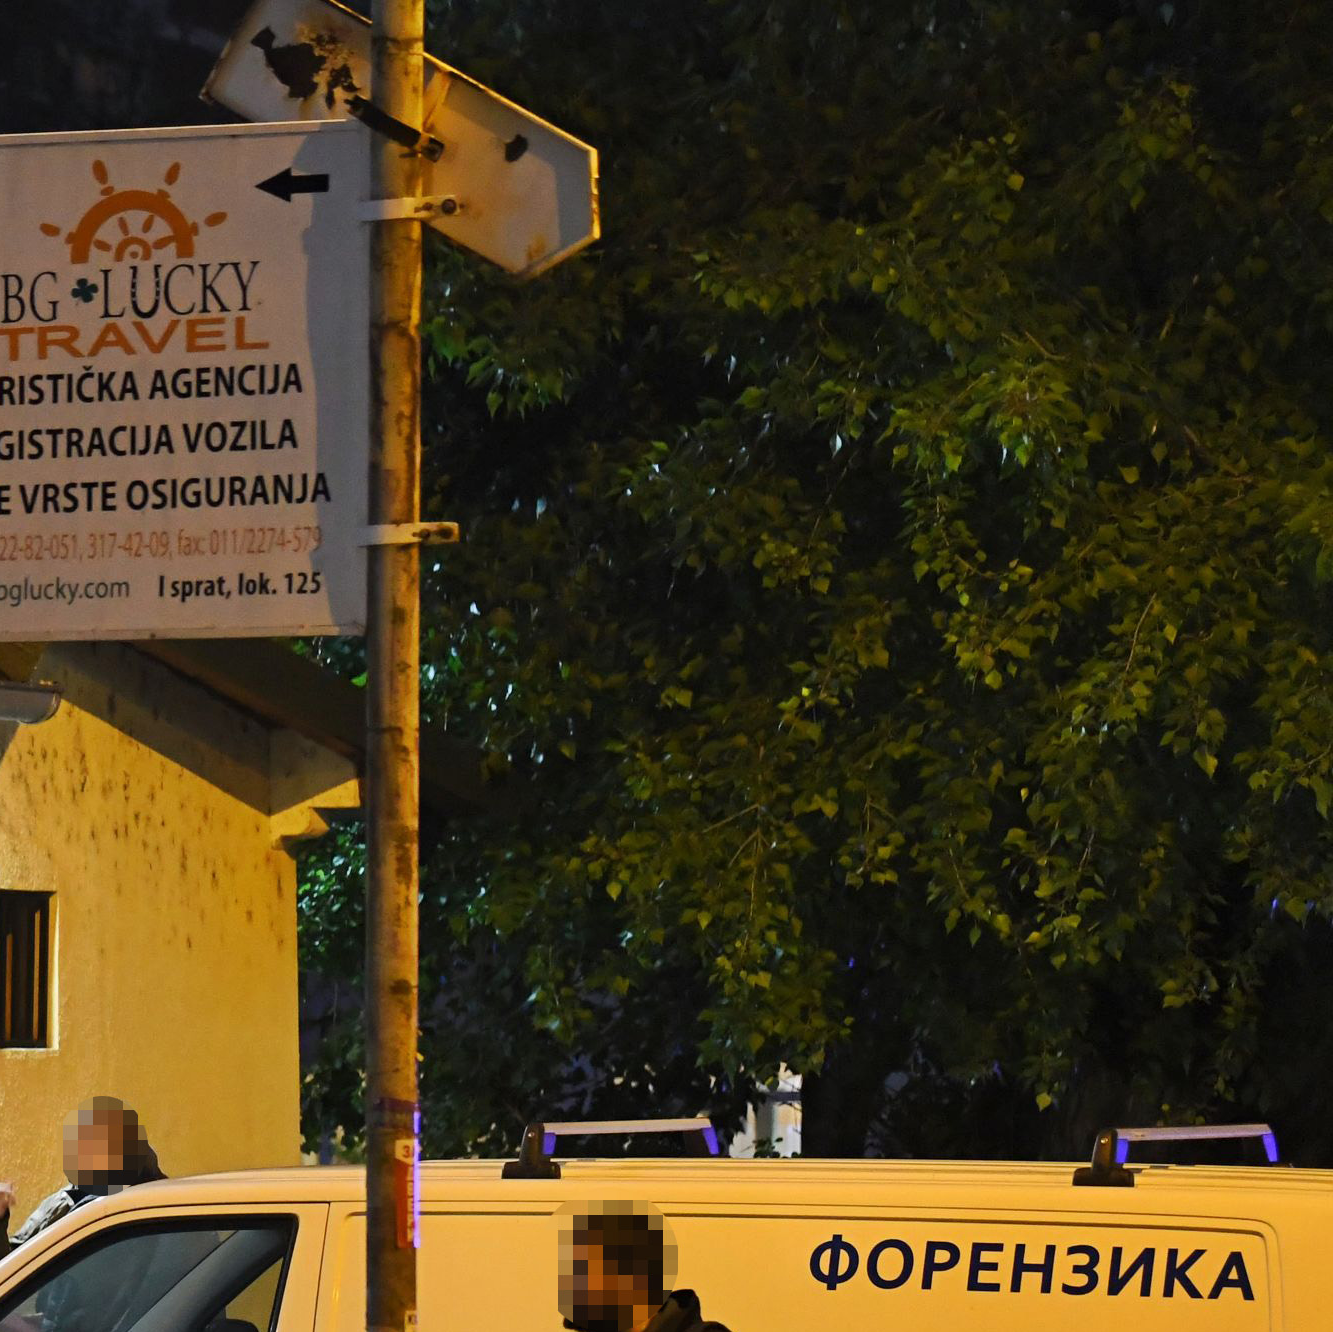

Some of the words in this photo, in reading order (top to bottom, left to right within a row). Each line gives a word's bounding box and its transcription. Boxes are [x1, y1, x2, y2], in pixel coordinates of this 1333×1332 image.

[0, 271, 59, 324] BG
[99, 260, 261, 320] LUCKY
[149, 362, 303, 400] AGENCIJA
[182, 418, 298, 453] VOZILA
[19, 480, 117, 514] VRSTE
[126, 472, 332, 511] OSIGURANJA
[170, 575, 232, 602] sprat,
[238, 572, 278, 597] lok.
[284, 571, 322, 595] 125
[808, 1234, 1255, 1301] ФОРЕНЗИКА
